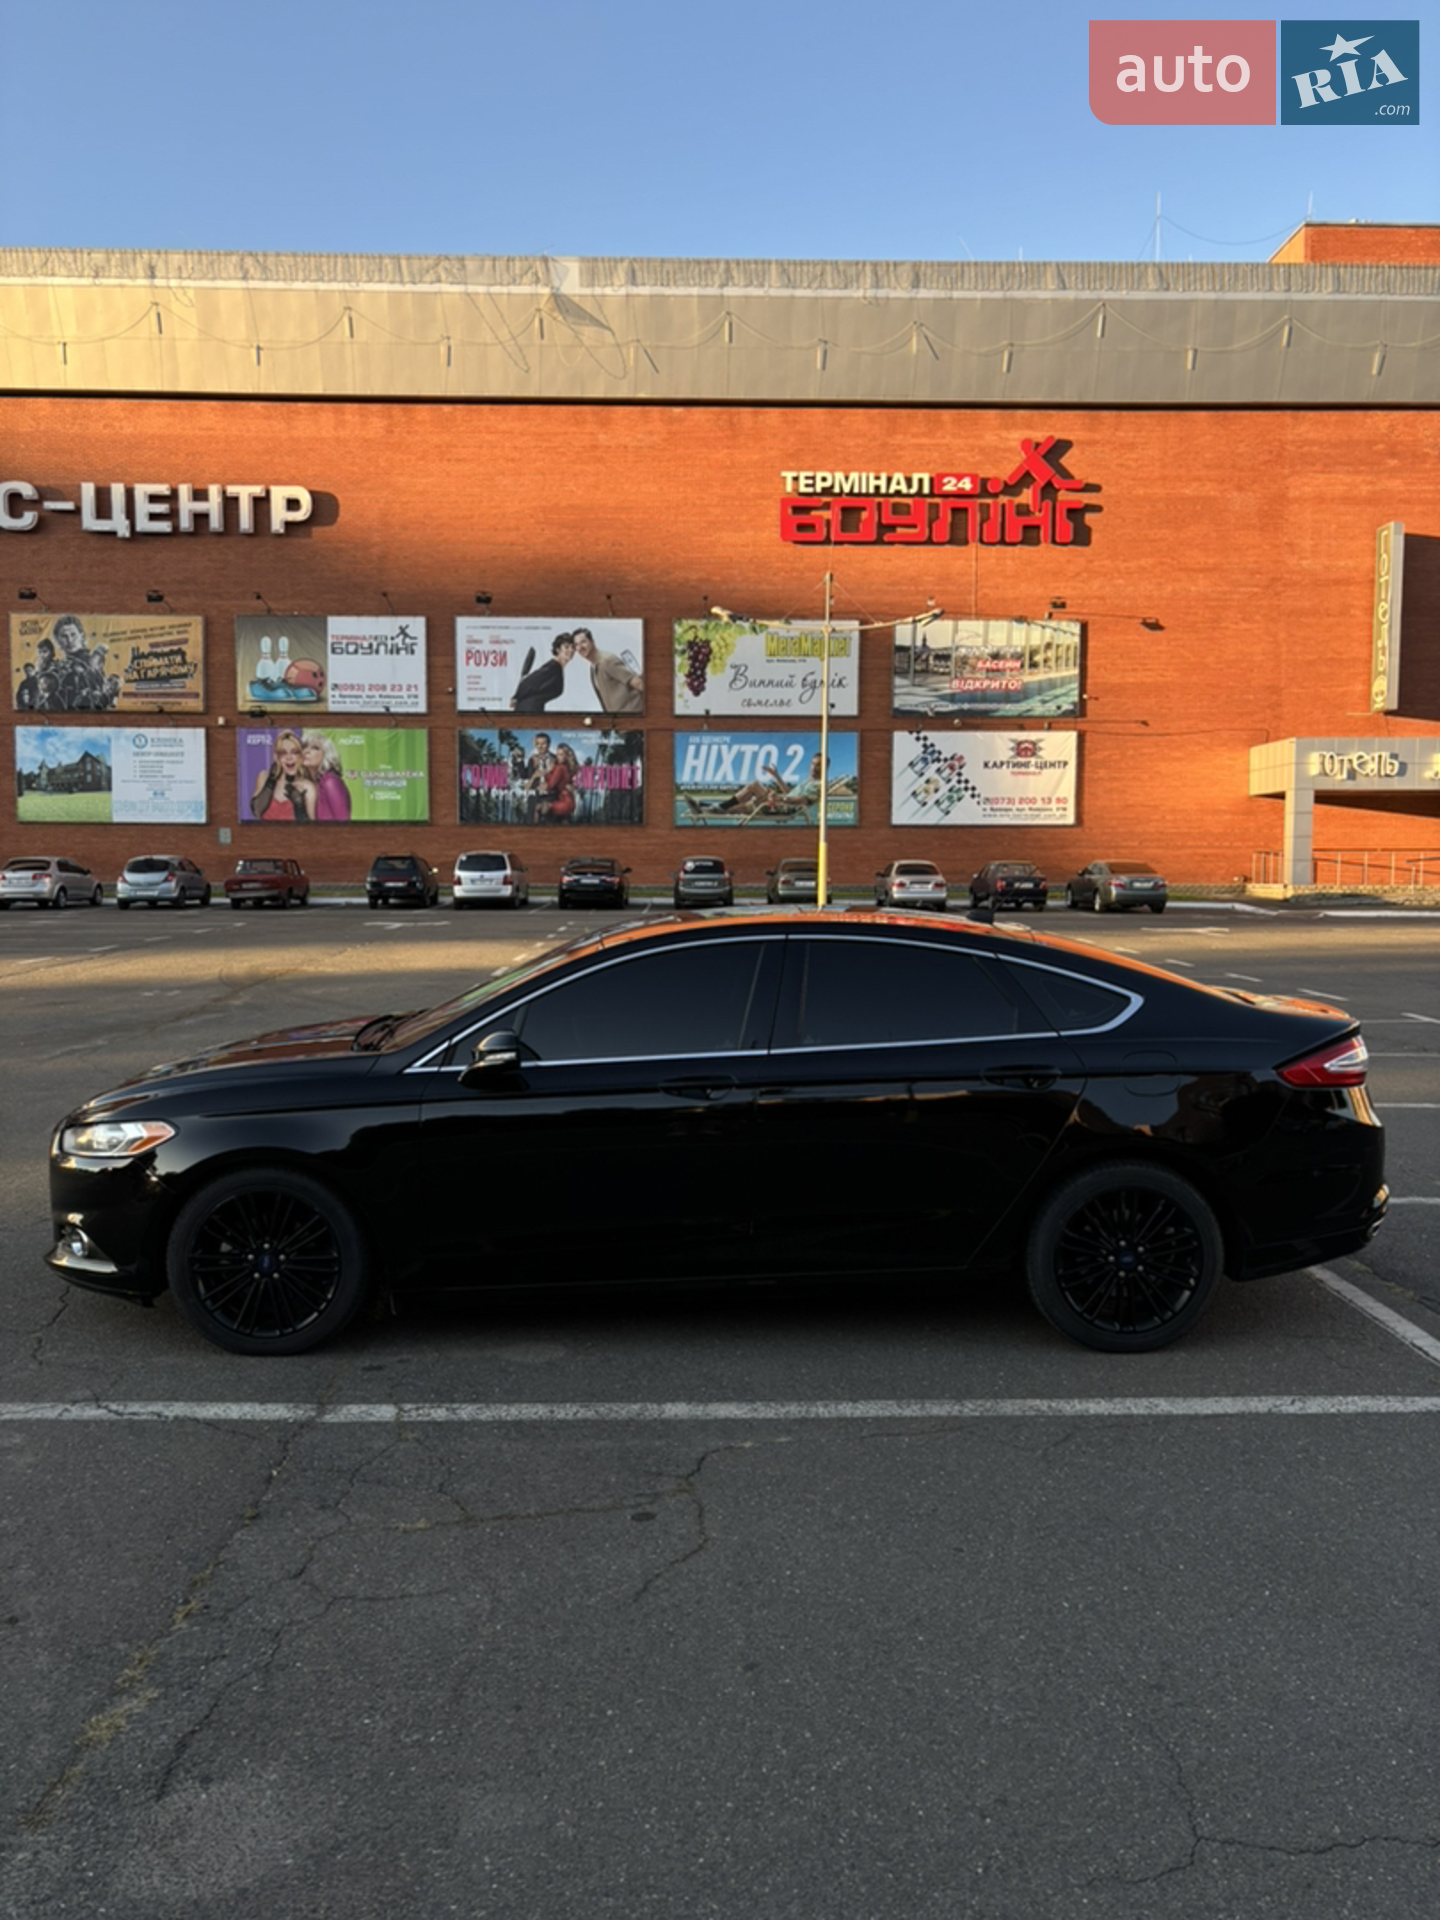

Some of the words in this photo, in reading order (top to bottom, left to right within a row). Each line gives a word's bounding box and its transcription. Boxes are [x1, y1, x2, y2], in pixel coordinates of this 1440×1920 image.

[781, 471, 930, 494] ТЕРМІНАЛ
[941, 476, 973, 491] 24
[0, 480, 312, 538] С-ЦЕНТР
[780, 498, 1083, 544] БОУЛІНГ
[330, 642, 418, 655] БОУЛІНГ
[465, 650, 508, 667] РОУЗИ
[728, 663, 797, 692] Винний
[951, 679, 1022, 691] ВІДКРИТО!
[681, 744, 779, 783] НІХТО
[782, 743, 804, 783] 2
[983, 760, 1069, 770] КАРТИНГ-ЦЕНТР
